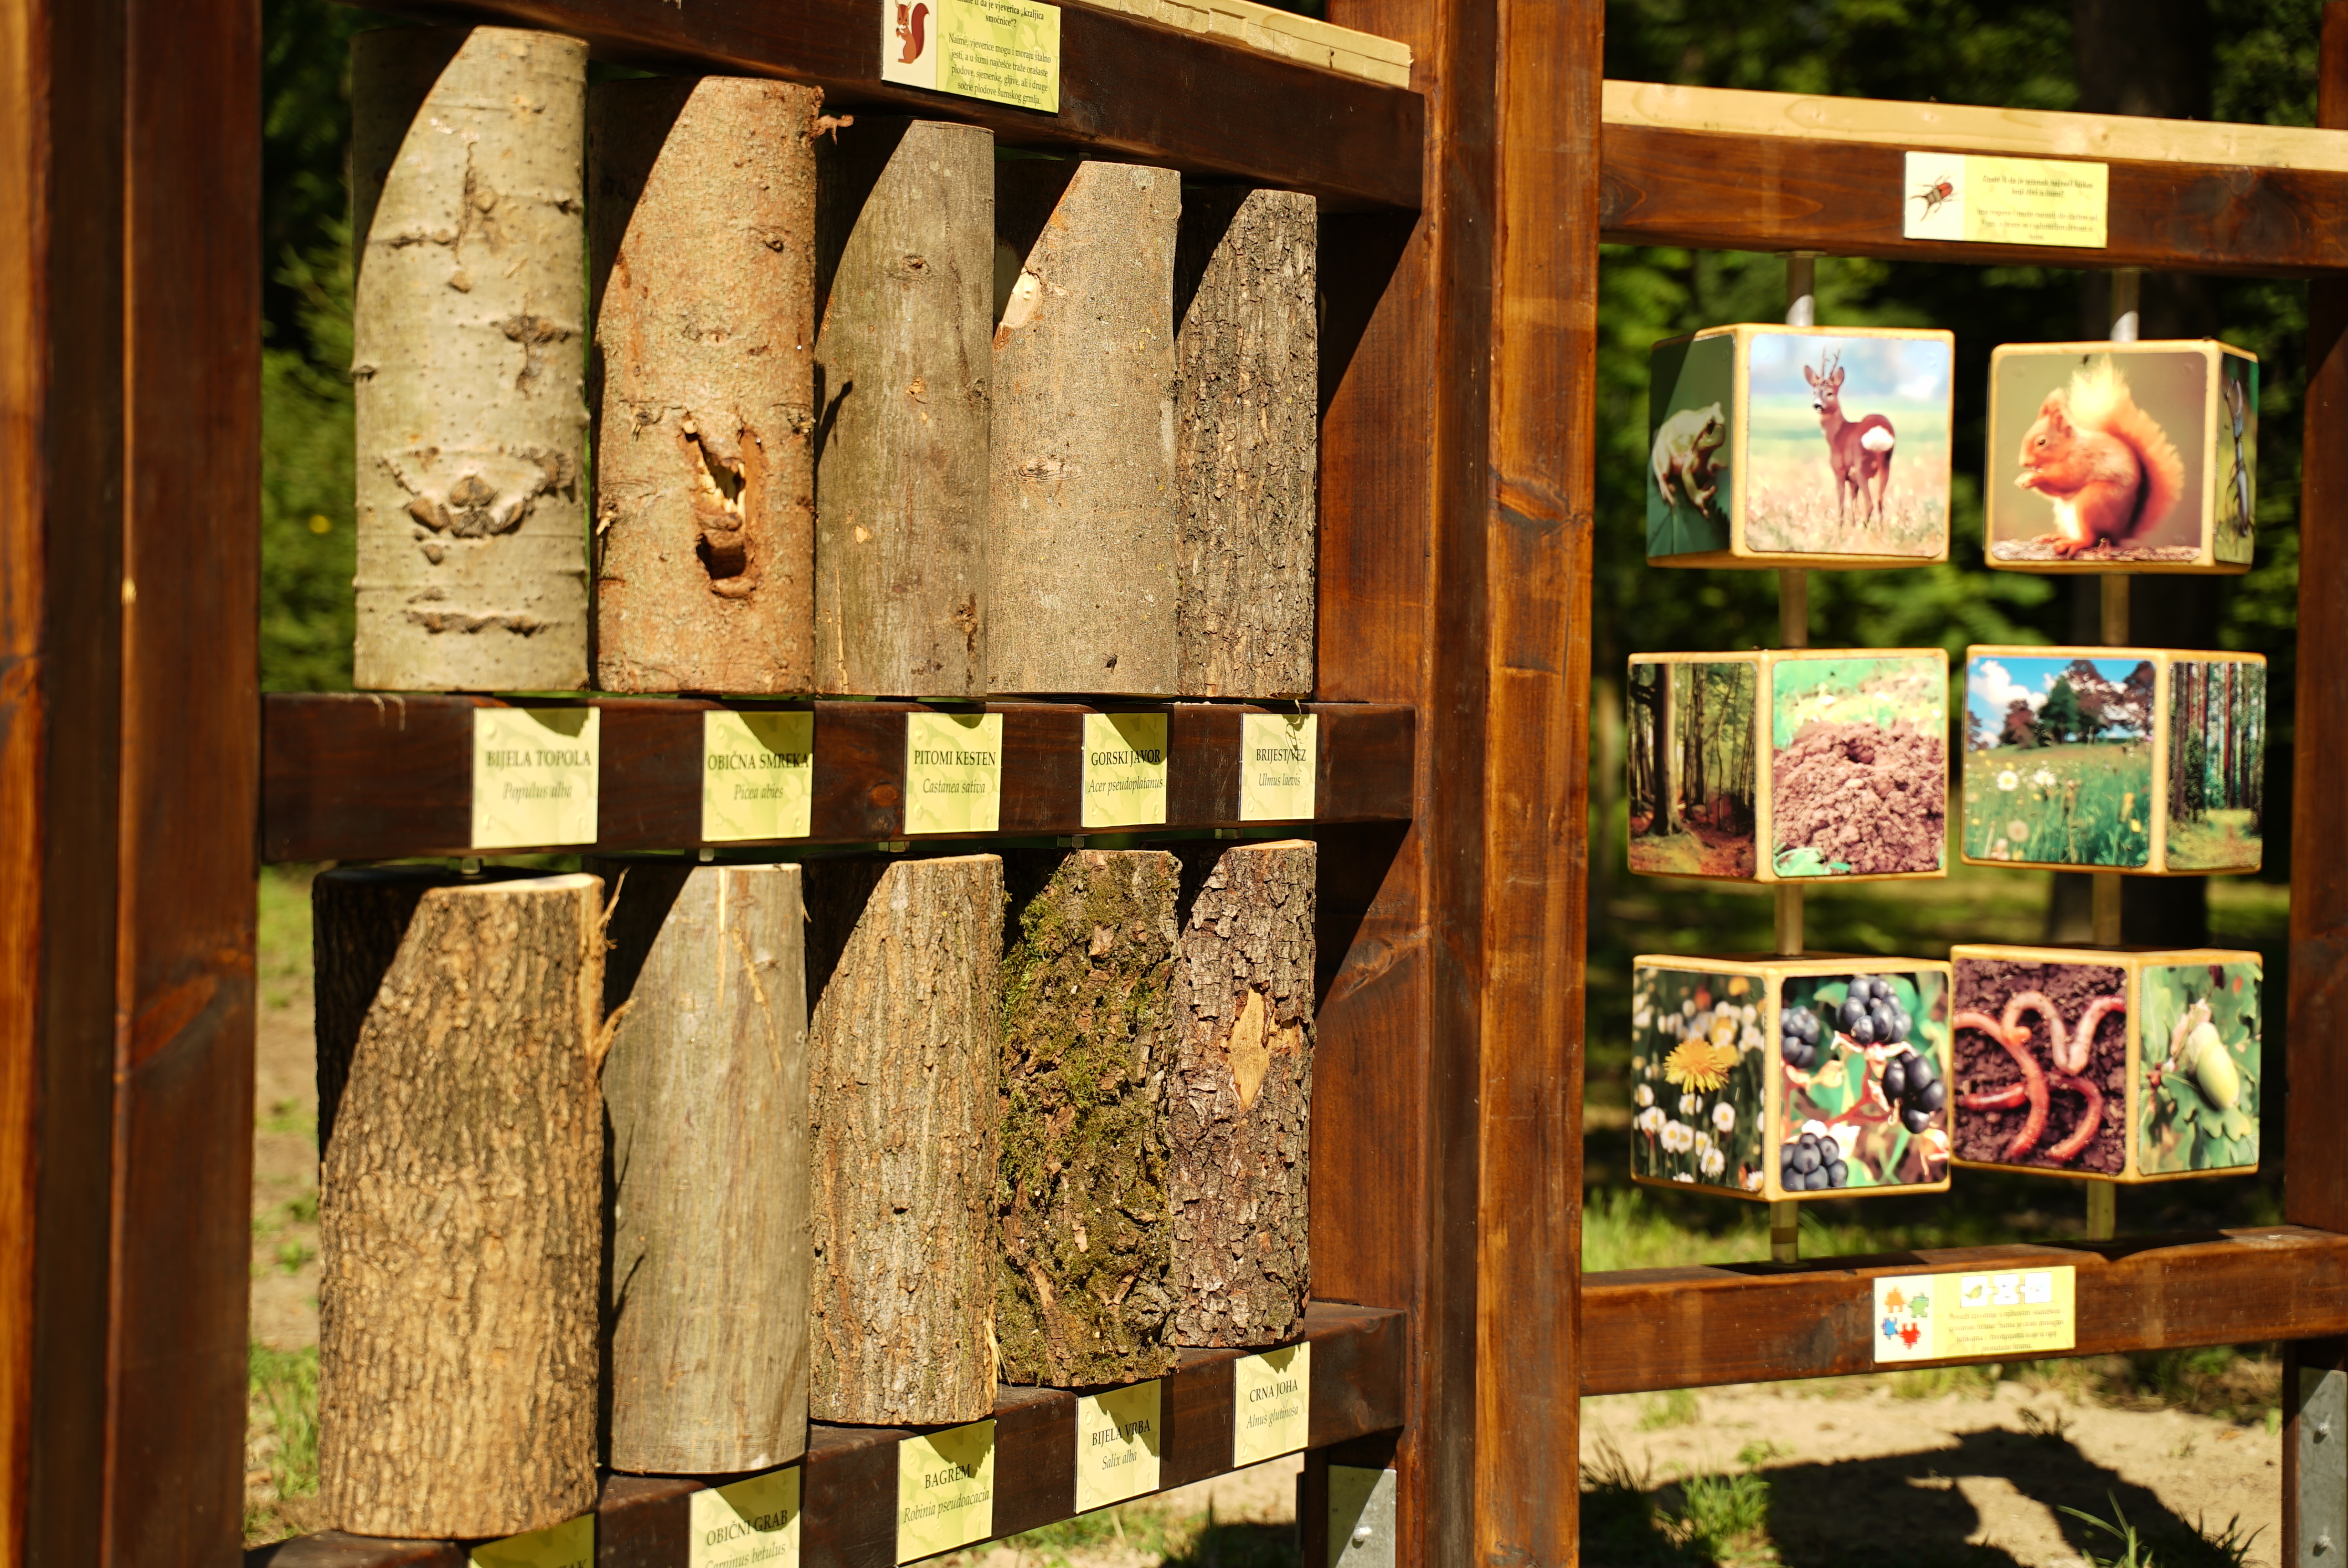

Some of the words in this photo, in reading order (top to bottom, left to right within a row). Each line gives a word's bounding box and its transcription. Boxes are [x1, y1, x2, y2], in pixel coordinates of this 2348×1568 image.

[988, 0, 994, 11] je
[995, 3, 1019, 14] vjeverica
[948, 33, 969, 48] Naime,
[970, 39, 995, 51] vjeverice
[995, 45, 1011, 57] mogu
[1015, 49, 1034, 61] moraju
[1035, 53, 1051, 63] stalno
[950, 49, 964, 61] jesti,
[975, 55, 988, 64] šumi
[990, 59, 1011, 69] najčešće
[1012, 62, 1026, 73] traže
[1027, 67, 1048, 77] orašaste
[951, 64, 975, 78] plodove,
[976, 69, 1003, 82] sjemenke,
[1004, 74, 1020, 86] gljive,
[1032, 81, 1048, 94] druge
[957, 82, 974, 91] sočne
[974, 84, 997, 95] plodove
[997, 88, 1021, 103] šumskog
[1022, 95, 1041, 106] grmlja.
[486, 750, 533, 771] BIJELA
[535, 750, 592, 767] TOPOLA
[707, 750, 756, 771] OBIČNA
[759, 752, 810, 769] SMREKA
[914, 750, 953, 765] PITOMI
[955, 751, 996, 766] KESTEN
[1091, 751, 1128, 766] GORSKI
[1130, 749, 1161, 767] JAVOR
[923, 778, 960, 793] Castanea
[961, 778, 985, 793] sativa
[1088, 778, 1106, 793] Acer
[1108, 776, 1163, 796] pseudoplatanus
[1259, 773, 1281, 786] Ulmus
[1282, 773, 1301, 786] laevis
[503, 781, 548, 804] Populus
[549, 781, 573, 798] alba
[733, 783, 759, 801] Picea
[761, 782, 784, 800] abies
[1249, 1385, 1274, 1402] CRNA
[1275, 1379, 1298, 1399] JOHA
[1246, 1414, 1268, 1428] Alnus
[1268, 1405, 1299, 1427] glutinosa
[1092, 1426, 1122, 1447] BIJELA
[1125, 1419, 1151, 1437] VRBA
[1102, 1453, 1121, 1470] Salix
[1122, 1449, 1137, 1464] alba
[925, 1463, 971, 1489] BAGREM
[904, 1501, 935, 1523] Robinia
[937, 1487, 990, 1519] pseudoacacia
[707, 1519, 751, 1546] OBIČNI
[754, 1509, 788, 1532] GRAB
[752, 1541, 786, 1564] betulus
